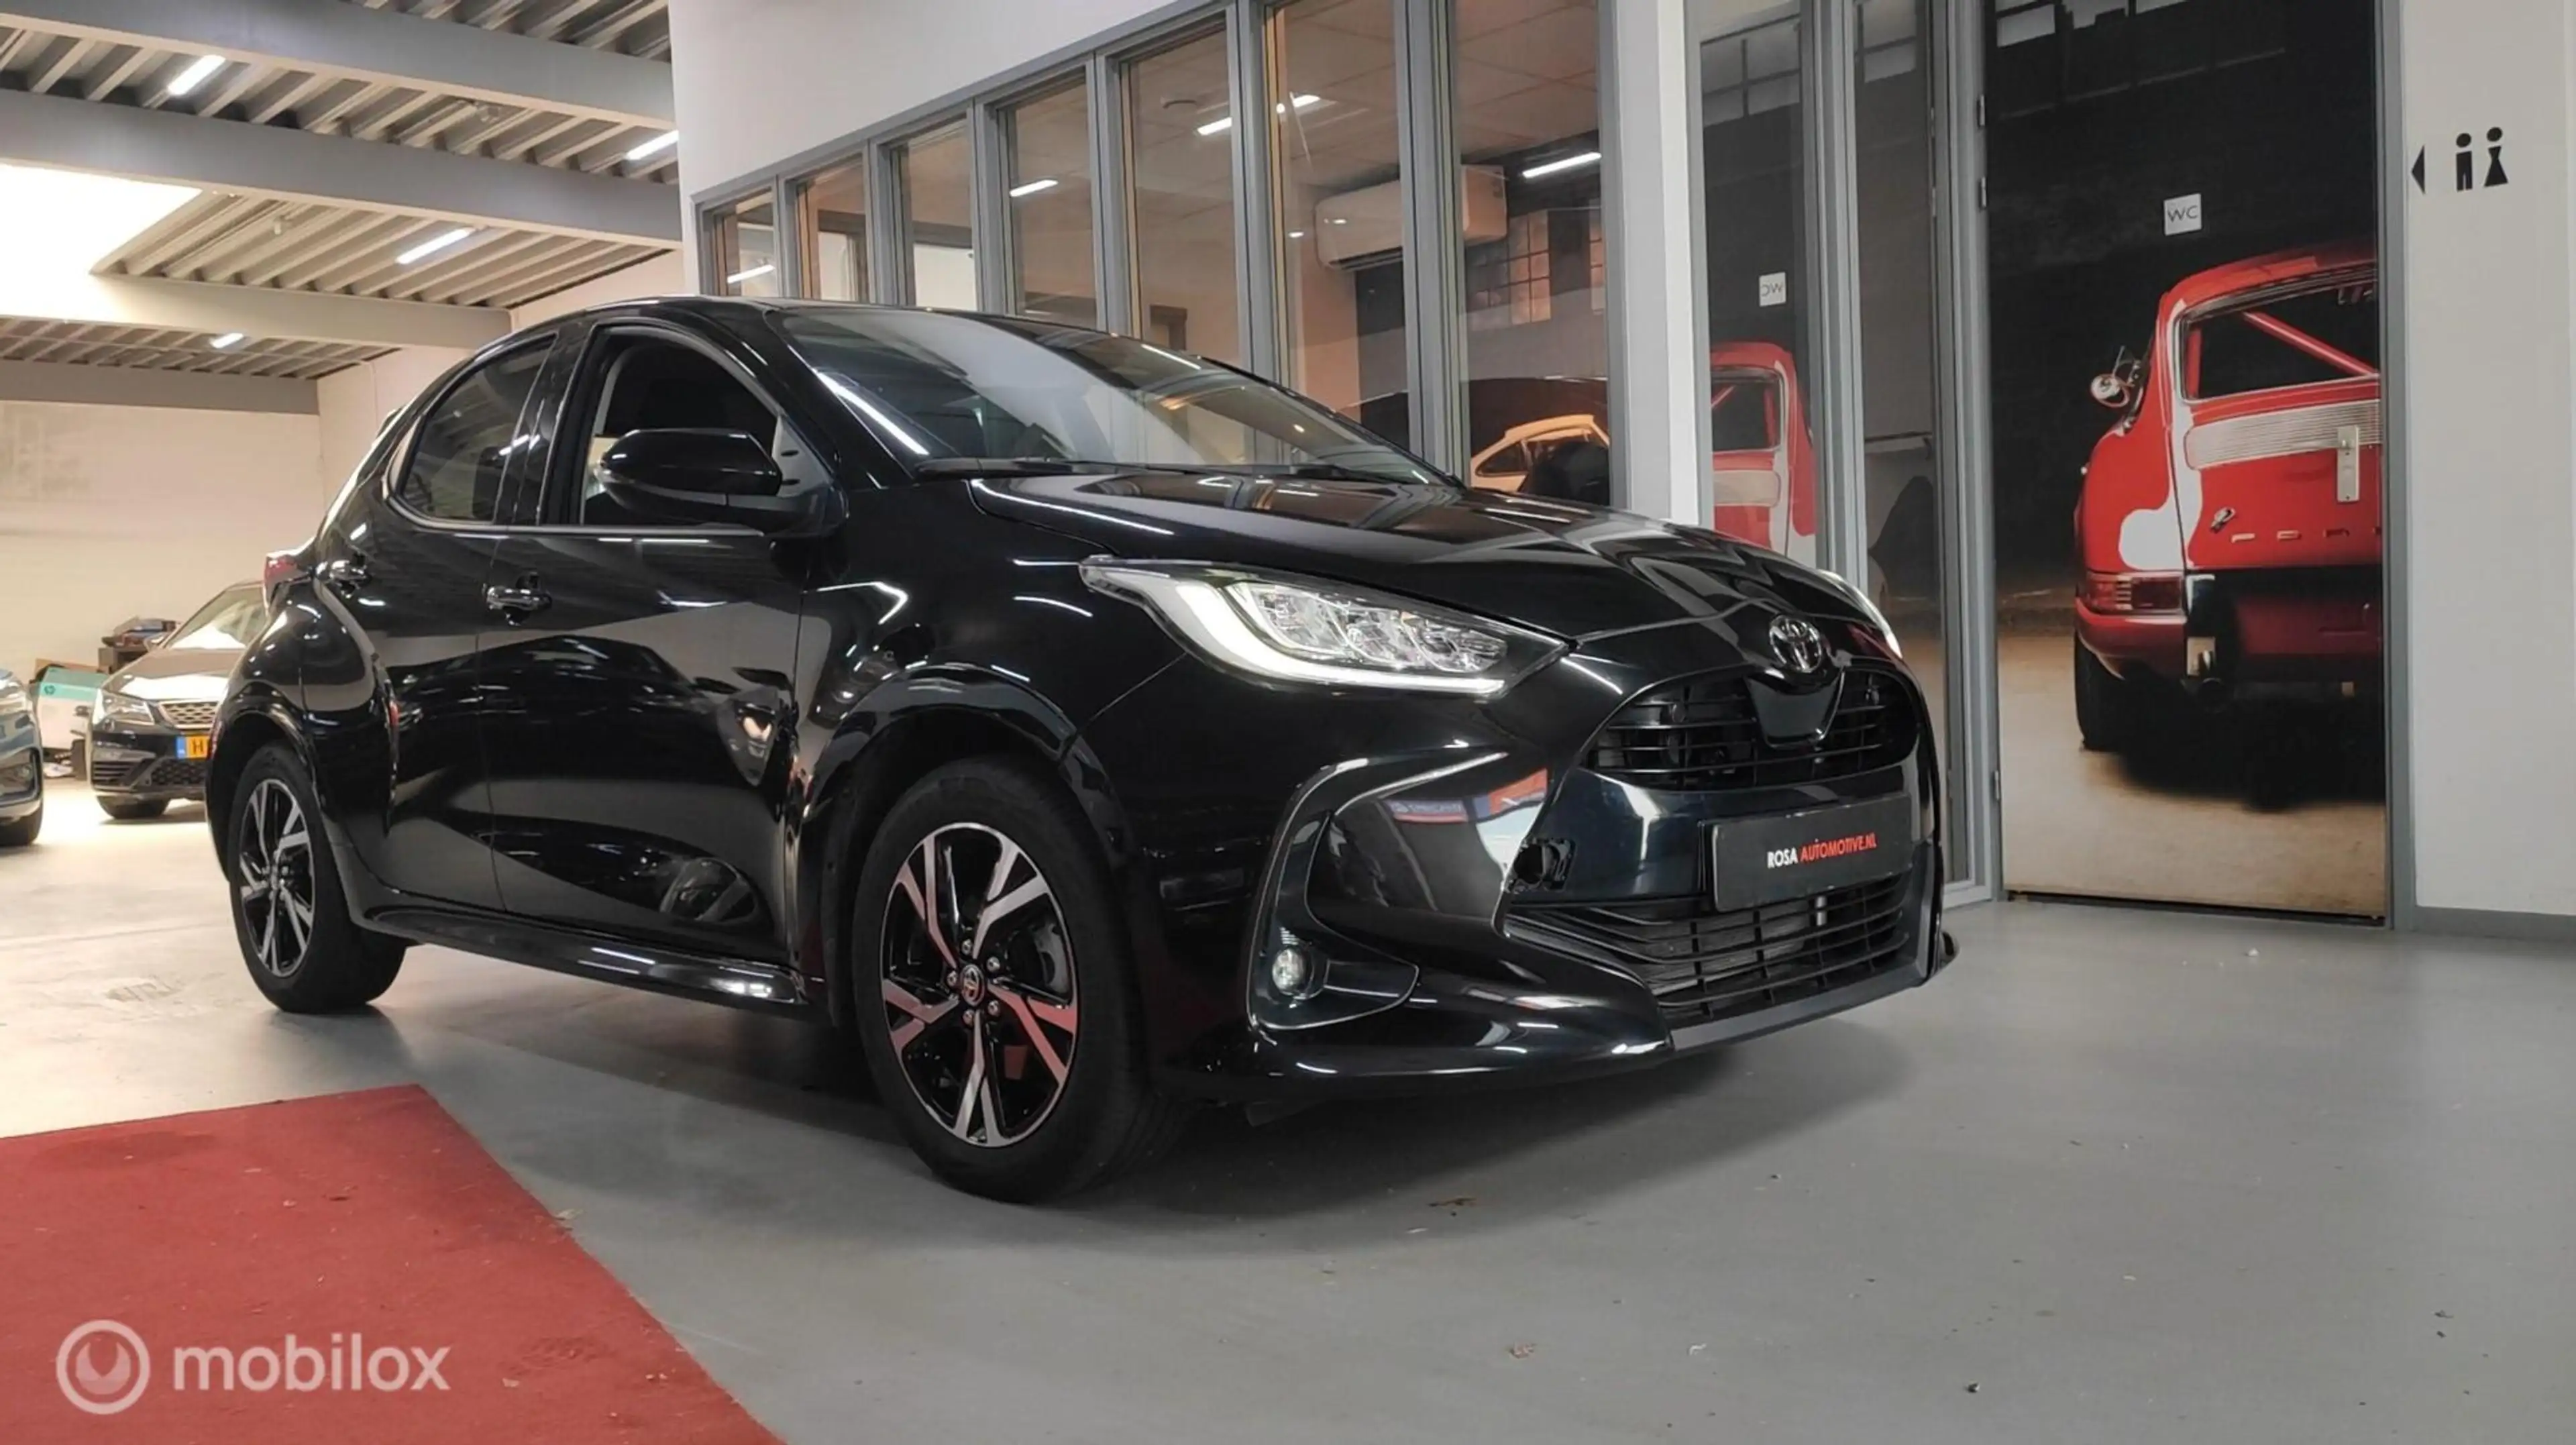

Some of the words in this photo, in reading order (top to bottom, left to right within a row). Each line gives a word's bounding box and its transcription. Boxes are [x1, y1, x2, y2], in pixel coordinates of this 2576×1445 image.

[2167, 205, 2198, 223] WC
[1767, 847, 1798, 869] ROSA
[1800, 833, 1877, 863] AUTOMOTIVE.NL
